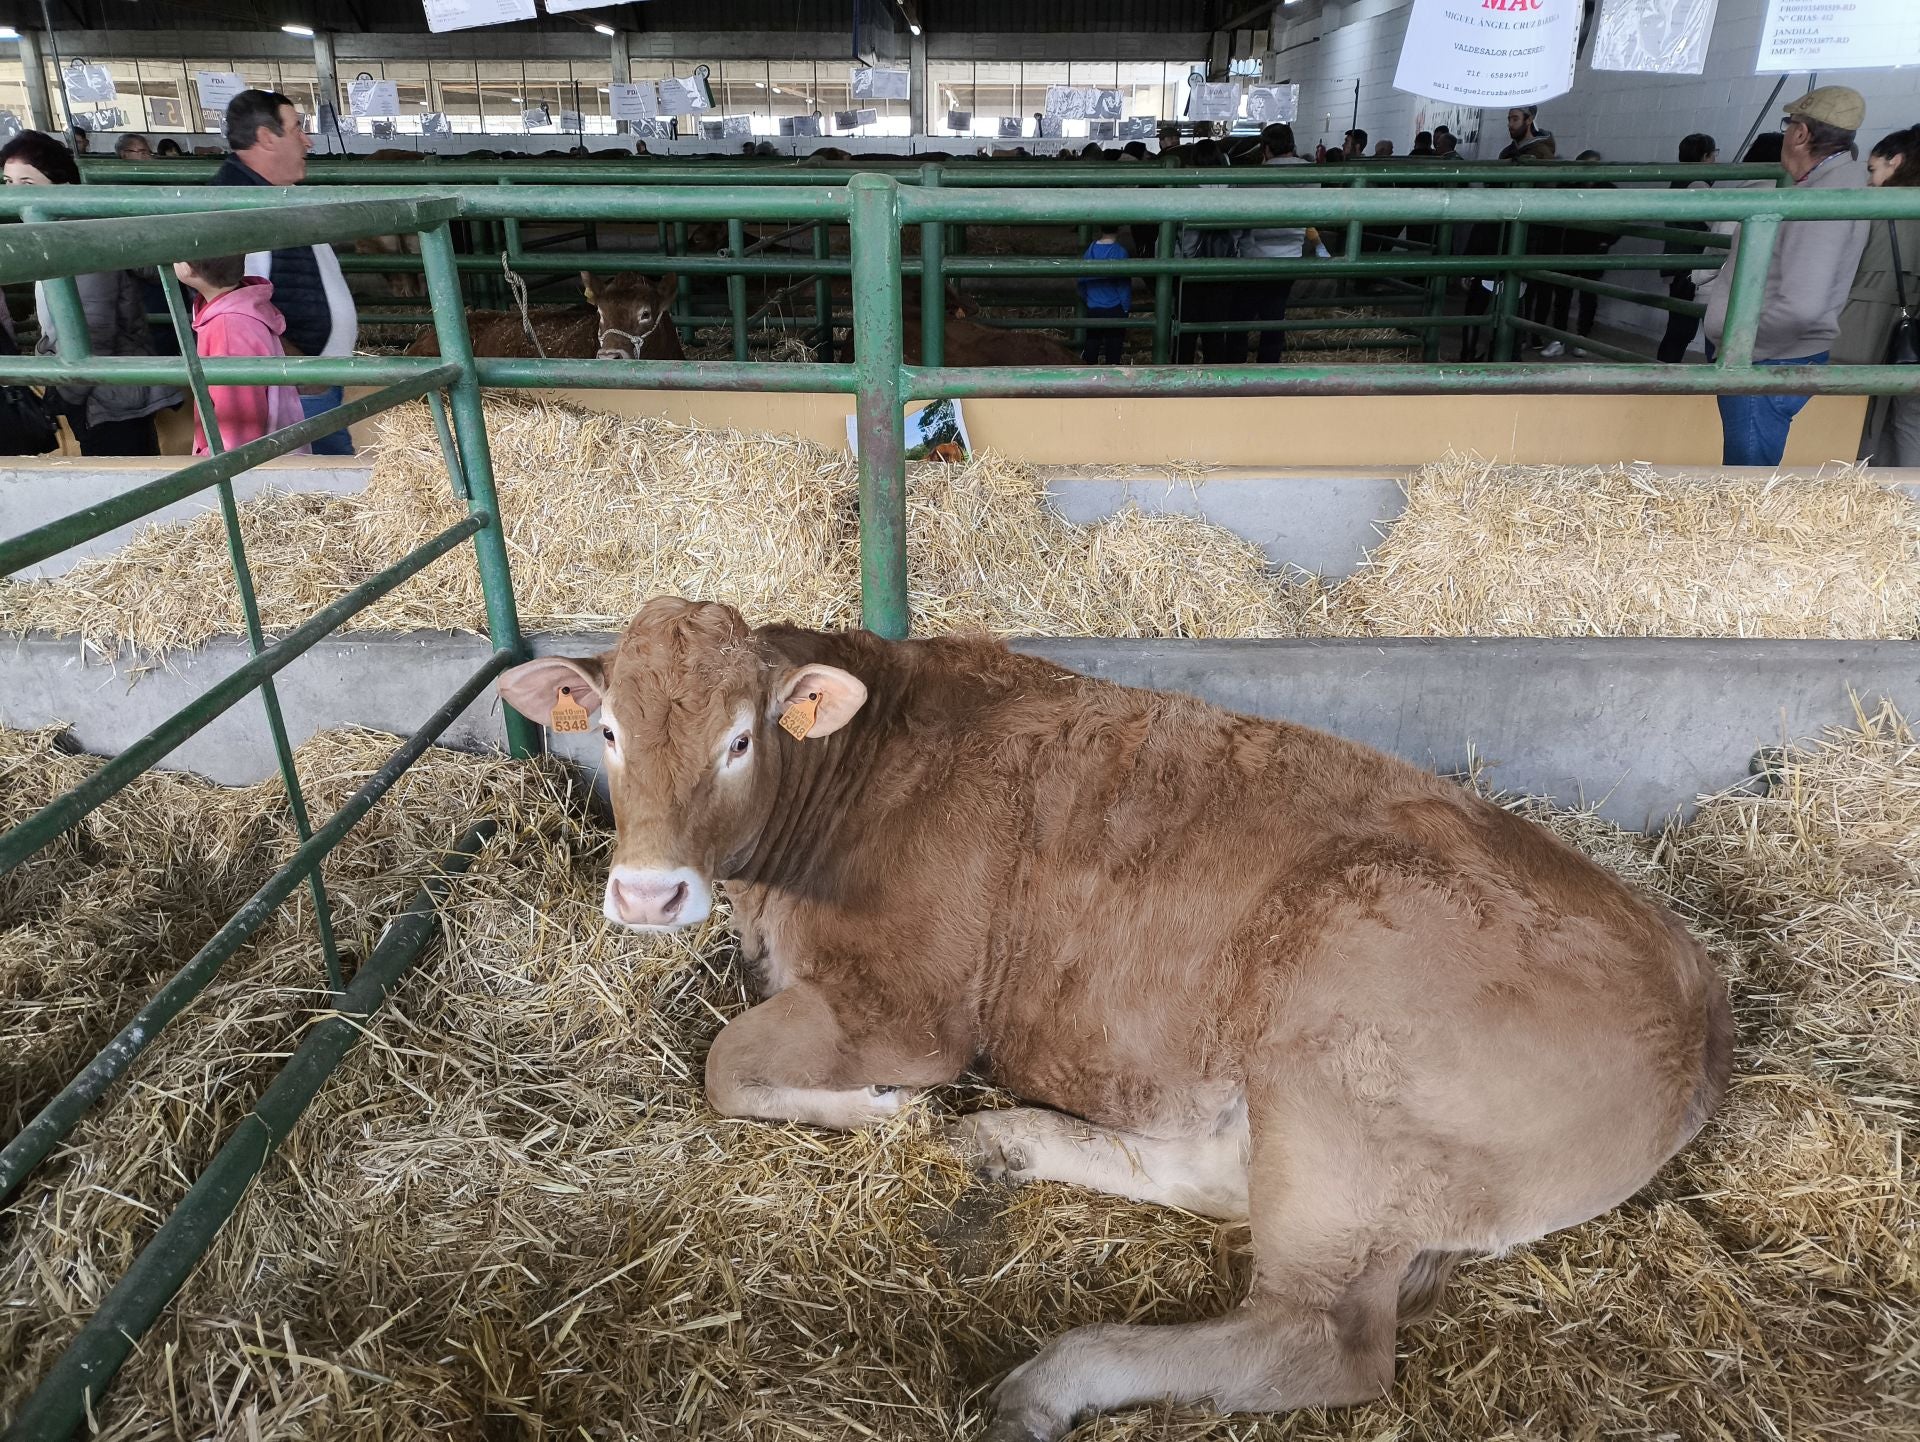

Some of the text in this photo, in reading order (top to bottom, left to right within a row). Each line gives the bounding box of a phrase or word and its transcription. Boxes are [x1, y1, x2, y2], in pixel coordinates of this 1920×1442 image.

[1444, 10, 1474, 25] MIGUEL
[1513, 20, 1536, 30] CRUZ
[1772, 28, 1819, 37] JANDILLA
[555, 719, 588, 732] 5348
[780, 715, 806, 738] 5348
